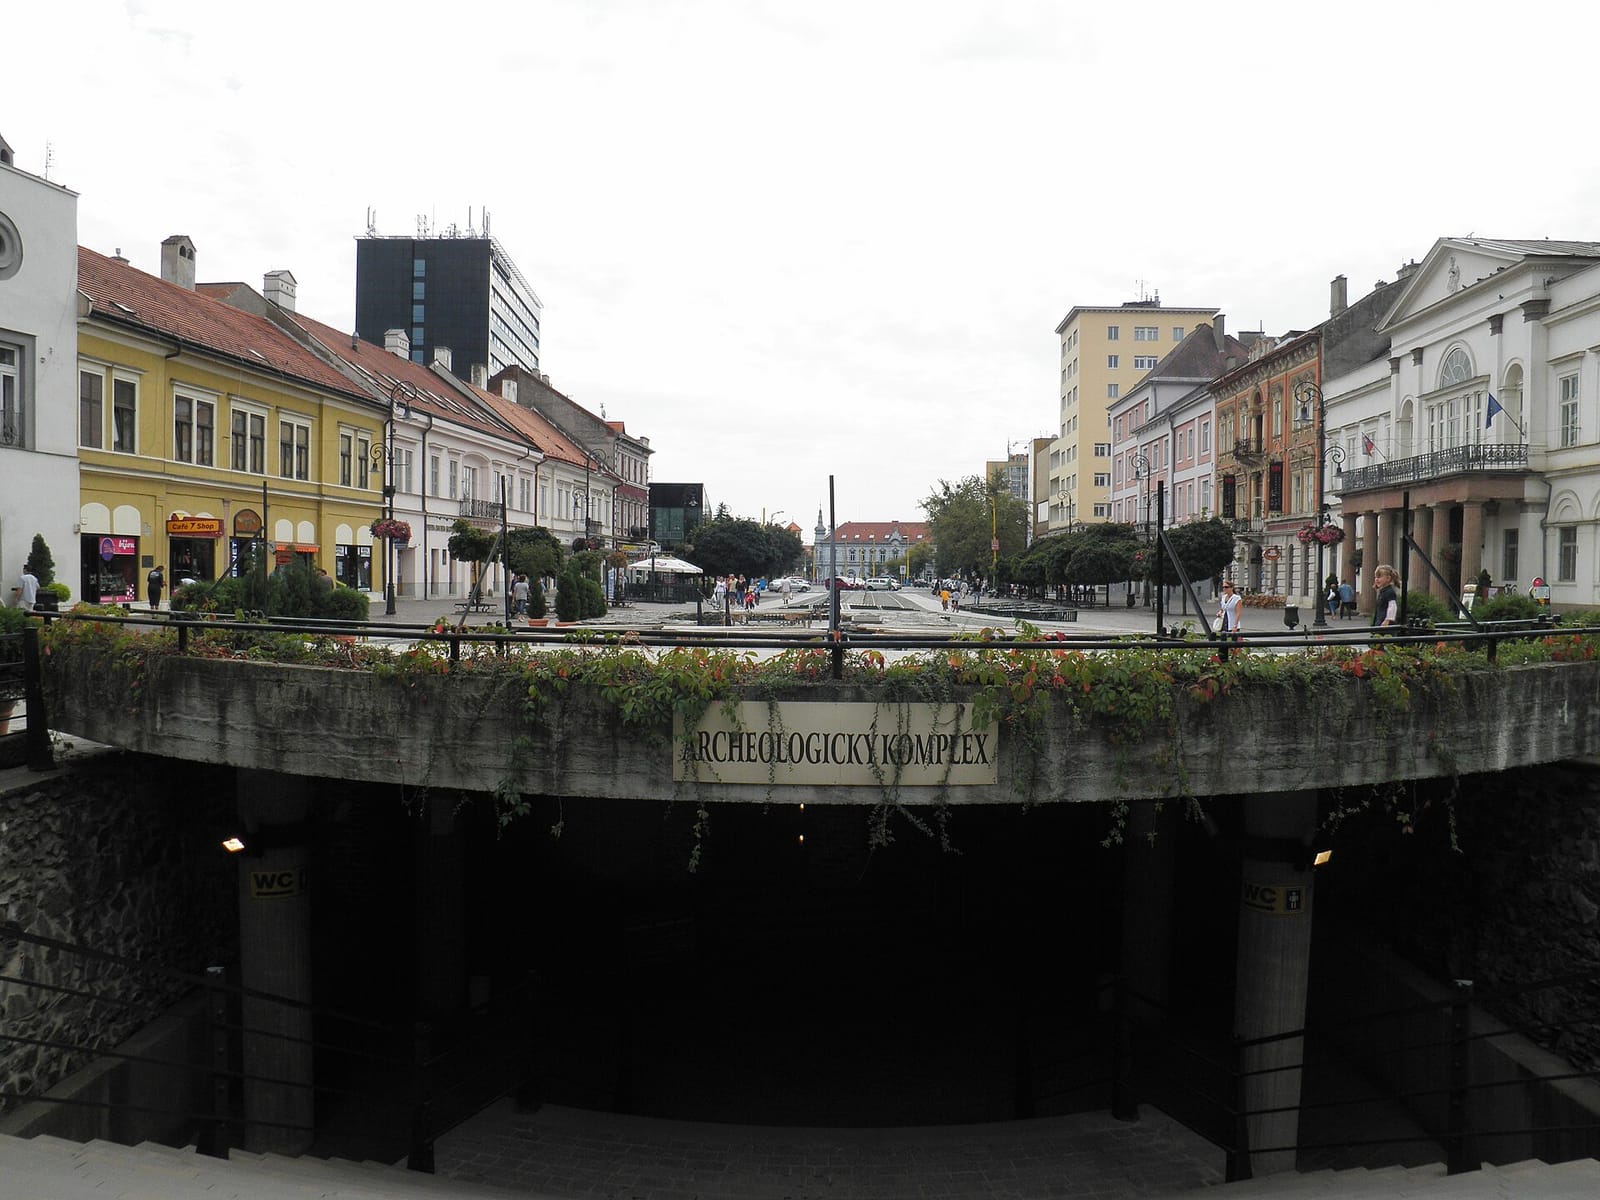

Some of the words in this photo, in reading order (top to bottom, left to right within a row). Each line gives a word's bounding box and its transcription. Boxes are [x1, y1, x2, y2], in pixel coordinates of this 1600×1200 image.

[197, 523, 214, 531] Shop
[881, 733, 989, 766] KOMPLEX
[253, 872, 294, 890] WC
[1244, 883, 1277, 904] WC
